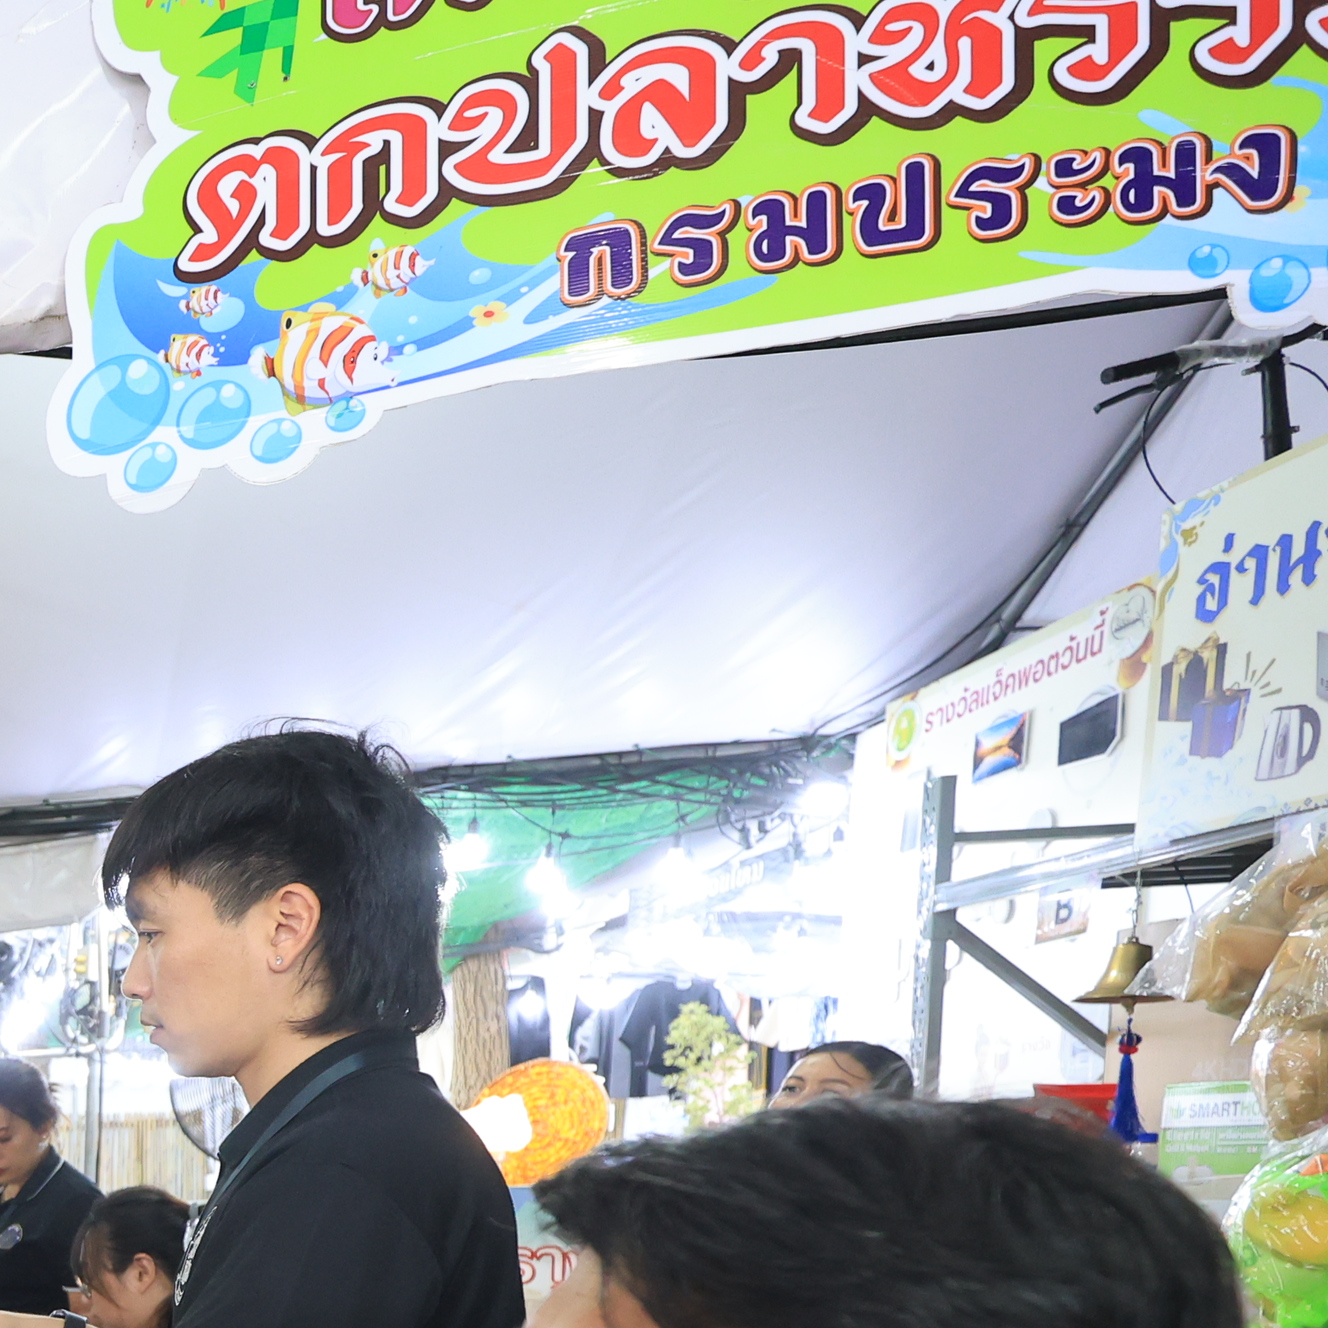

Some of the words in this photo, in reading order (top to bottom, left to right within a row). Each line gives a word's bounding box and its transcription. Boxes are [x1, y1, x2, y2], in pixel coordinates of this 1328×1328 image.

[178, 0, 1328, 285] ตกปลาหรร
[556, 124, 1301, 306] กรมประมง
[1195, 519, 1328, 624] อ่าน
[924, 606, 1110, 733] รางวัลแจ็คพอตวันนี้
[1189, 1100, 1262, 1119] SMARTHO
